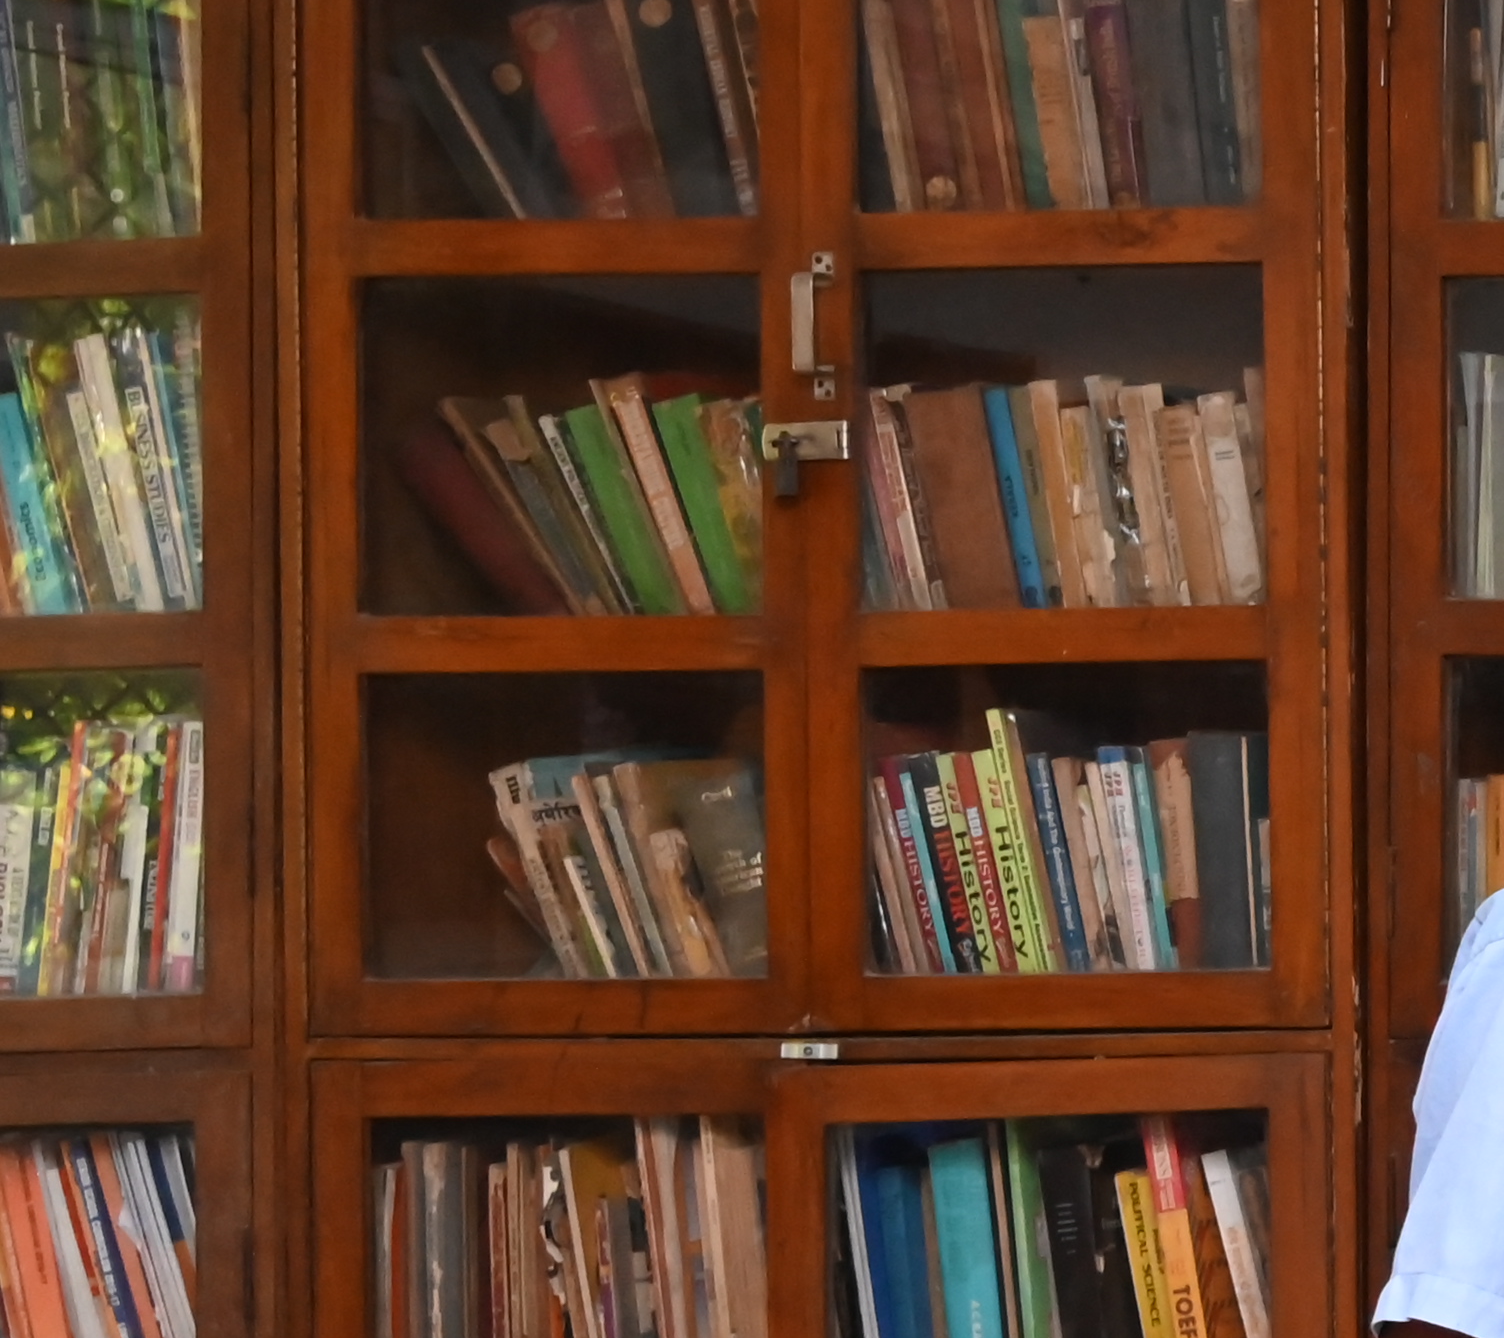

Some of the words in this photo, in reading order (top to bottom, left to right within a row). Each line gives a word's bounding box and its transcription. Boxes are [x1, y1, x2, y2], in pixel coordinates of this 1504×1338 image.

[922, 786, 948, 828] MBD
[903, 836, 933, 933] HISTORY
[932, 830, 972, 934] HISTORY
[955, 832, 993, 963] History
[973, 836, 1003, 934] HISTORY
[995, 826, 1030, 959] History
[1127, 1181, 1150, 1261] POLITICAL
[1141, 1262, 1163, 1327] SCIENCE
